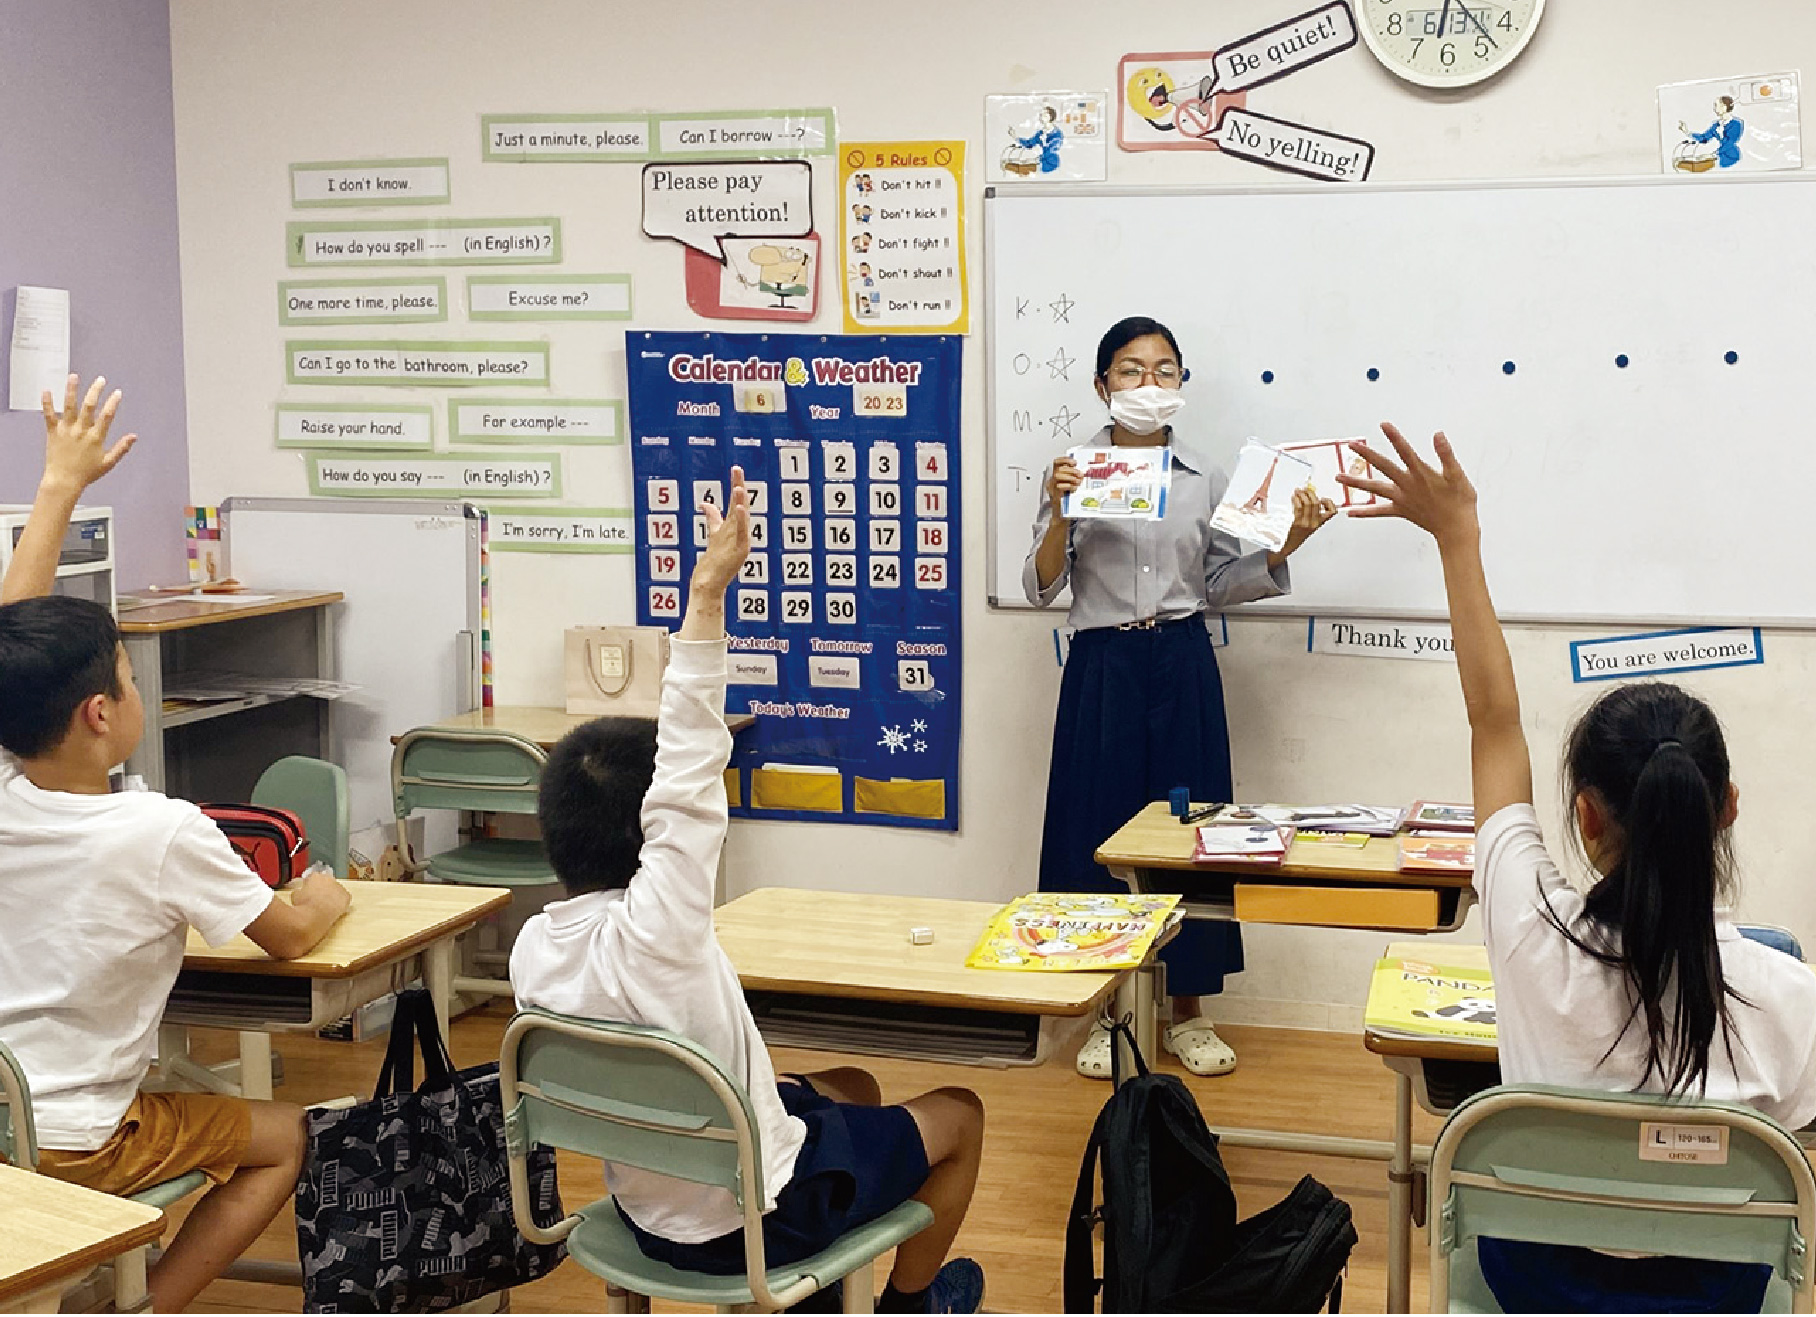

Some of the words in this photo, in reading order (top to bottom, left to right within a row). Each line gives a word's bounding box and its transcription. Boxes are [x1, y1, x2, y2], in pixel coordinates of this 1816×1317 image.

[1387, 12, 1401, 35] 8
[1423, 12, 1435, 34] 6
[1496, 11, 1511, 31] 4
[1226, 52, 1260, 78] Be
[1267, 16, 1336, 64] quiet!
[1410, 37, 1424, 60] 7
[1440, 42, 1455, 66] 6
[1474, 36, 1488, 58] 5
[495, 132, 524, 147] Just
[529, 136, 537, 147] a
[540, 132, 592, 148] minute,
[596, 131, 643, 148] please.
[680, 129, 704, 144] Can
[709, 129, 717, 143] I
[721, 127, 772, 143] borrow
[1226, 119, 1261, 148] No
[1265, 131, 1360, 176] yelling!
[875, 154, 884, 167] 5
[890, 153, 928, 167] Rules
[328, 178, 335, 191] I
[339, 178, 371, 191] don't
[376, 177, 412, 191] know.
[651, 170, 718, 190] Please
[725, 173, 763, 195] pay
[881, 179, 911, 192] Don't
[915, 180, 932, 190] hit
[685, 201, 788, 223] attention!
[880, 208, 911, 220] Don't
[914, 208, 937, 219] kick
[315, 240, 344, 255] How
[348, 240, 363, 254] do
[367, 242, 391, 256] you
[394, 238, 424, 255] spell
[464, 235, 481, 252] (in
[485, 235, 540, 254] English)
[878, 239, 908, 250] Don't
[913, 238, 939, 252] fight
[878, 268, 908, 280] Don't
[913, 267, 942, 279] shout
[288, 297, 314, 310] One
[317, 298, 351, 310] more
[355, 296, 388, 310] time,
[392, 295, 438, 312] please.
[509, 291, 558, 306] Excuse
[562, 292, 589, 306] me?
[889, 300, 918, 311] Don't
[923, 302, 942, 311] run
[299, 357, 322, 370] Can
[325, 357, 333, 370] I
[336, 359, 351, 373] go
[355, 357, 370, 370] to
[373, 357, 397, 370] the
[404, 357, 473, 374] bathroom,
[477, 359, 528, 376] please?
[670, 355, 783, 382] Calendar
[786, 357, 809, 386] &
[812, 357, 921, 386] Weather
[756, 393, 766, 406] 6
[677, 401, 721, 417] Month
[809, 405, 840, 420] Year
[301, 419, 335, 434] Raise
[338, 422, 367, 437] your
[370, 421, 405, 436] hand.
[482, 414, 507, 428] For
[510, 413, 567, 430] example
[791, 456, 798, 473] 1
[835, 456, 846, 473] 2
[879, 456, 890, 473] 3
[927, 456, 938, 473] 4
[322, 469, 350, 482] How
[353, 469, 369, 482] do
[372, 471, 397, 485] you
[401, 471, 422, 485] say
[463, 469, 481, 484] (in
[484, 468, 540, 486] English)
[658, 487, 669, 504] 5
[747, 490, 758, 505] 7
[792, 491, 802, 508] 8
[835, 491, 846, 506] 9
[876, 491, 896, 508] 10
[924, 493, 938, 510] 11
[502, 521, 524, 536] I'm
[528, 523, 568, 541] sorry,
[572, 523, 595, 538] I'm
[599, 523, 630, 539] late.
[653, 522, 673, 538] 12
[699, 522, 706, 539] 1
[788, 527, 806, 544] 15
[830, 527, 850, 544] 16
[874, 528, 894, 545] 17
[923, 528, 942, 545] 18
[655, 556, 675, 573] 19
[743, 557, 762, 578] 21
[787, 561, 809, 578] 22
[830, 562, 853, 579] 23
[873, 564, 897, 581] 24
[918, 565, 942, 582] 25
[652, 593, 676, 611] 26
[743, 598, 765, 615] 28
[787, 599, 809, 616] 29
[830, 600, 853, 617] 30
[1332, 624, 1406, 649] Thank
[728, 637, 789, 653] Yesterday
[809, 638, 873, 653] Tomorrow
[897, 641, 947, 656] Season
[1582, 653, 1618, 671] You
[1625, 651, 1657, 666] are
[1663, 640, 1754, 661] welcome.
[736, 665, 768, 675] Sunday
[817, 667, 850, 677] Tuesday
[905, 667, 925, 685] 31
[748, 701, 795, 718] Today's
[797, 704, 850, 719] Weather
[1656, 1130, 1666, 1144] L
